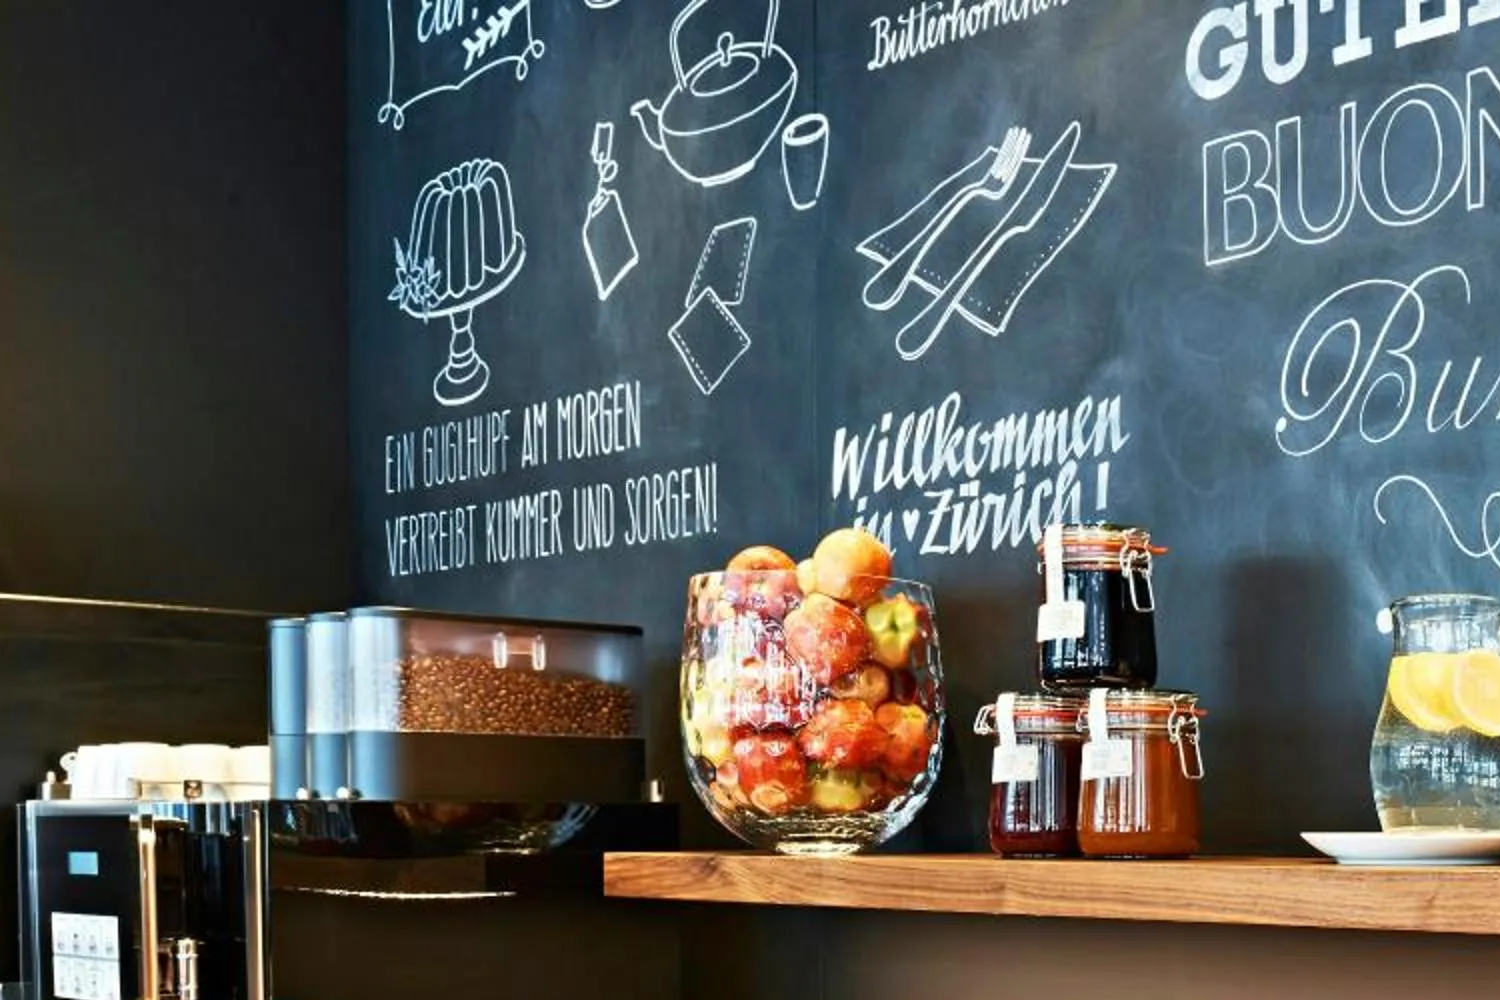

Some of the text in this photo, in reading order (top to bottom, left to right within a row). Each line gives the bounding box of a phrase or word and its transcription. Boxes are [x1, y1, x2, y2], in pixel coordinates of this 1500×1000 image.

[423, 409, 512, 488] GUGLHUPF
[521, 401, 548, 470] AM
[556, 380, 642, 461] MORGEN
[831, 391, 1131, 501] Willkommen
[485, 489, 563, 564] KUMMER
[573, 483, 614, 552] UND
[624, 461, 718, 545] SORGEN!
